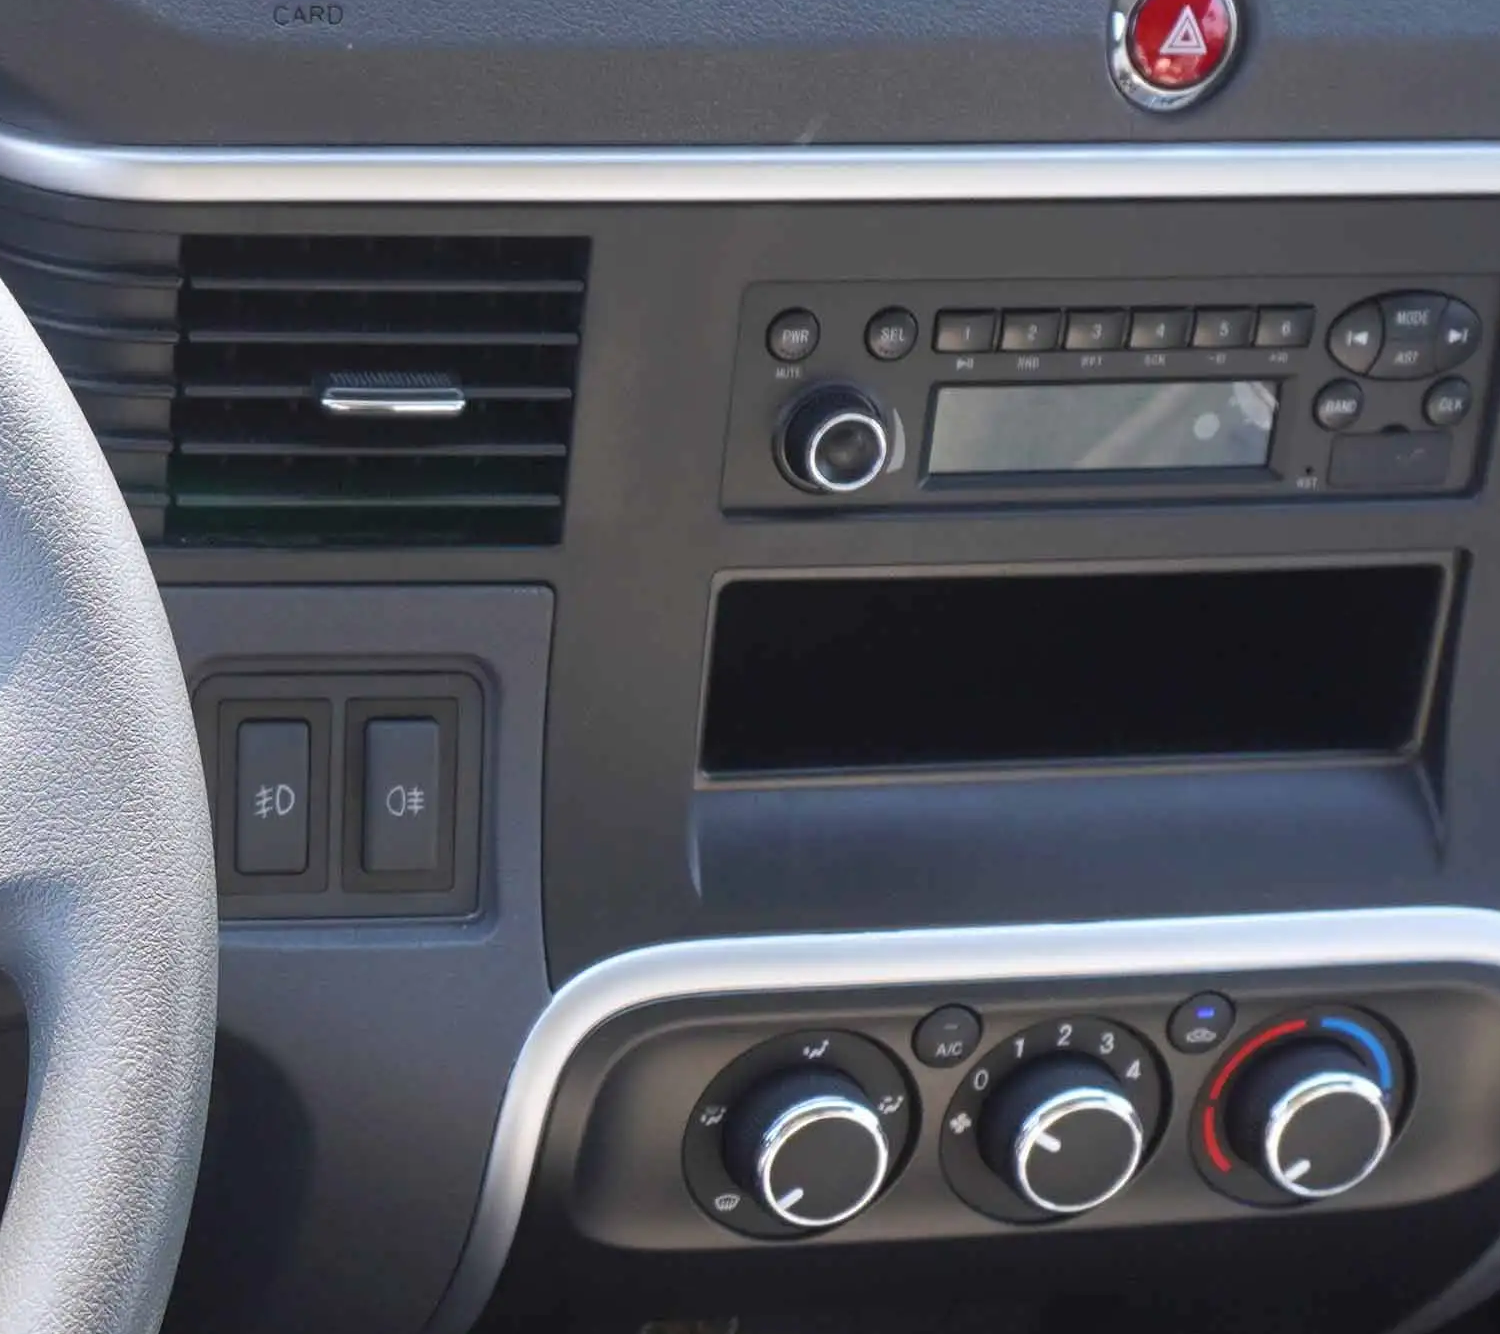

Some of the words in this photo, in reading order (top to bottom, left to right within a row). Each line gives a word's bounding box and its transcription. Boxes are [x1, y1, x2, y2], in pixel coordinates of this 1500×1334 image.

[272, 5, 344, 26] CARD
[1396, 310, 1430, 326] MODE
[782, 329, 810, 345] PWR
[880, 327, 905, 344] SEL
[1092, 323, 1104, 340] 3
[1219, 321, 1230, 338] 5
[1056, 1023, 1073, 1047] 2
[1099, 1032, 1115, 1055] 3
[935, 1041, 963, 1058] A/C
[1014, 1037, 1025, 1058] 1
[1126, 1058, 1141, 1081] 4
[973, 1068, 990, 1091] 0
